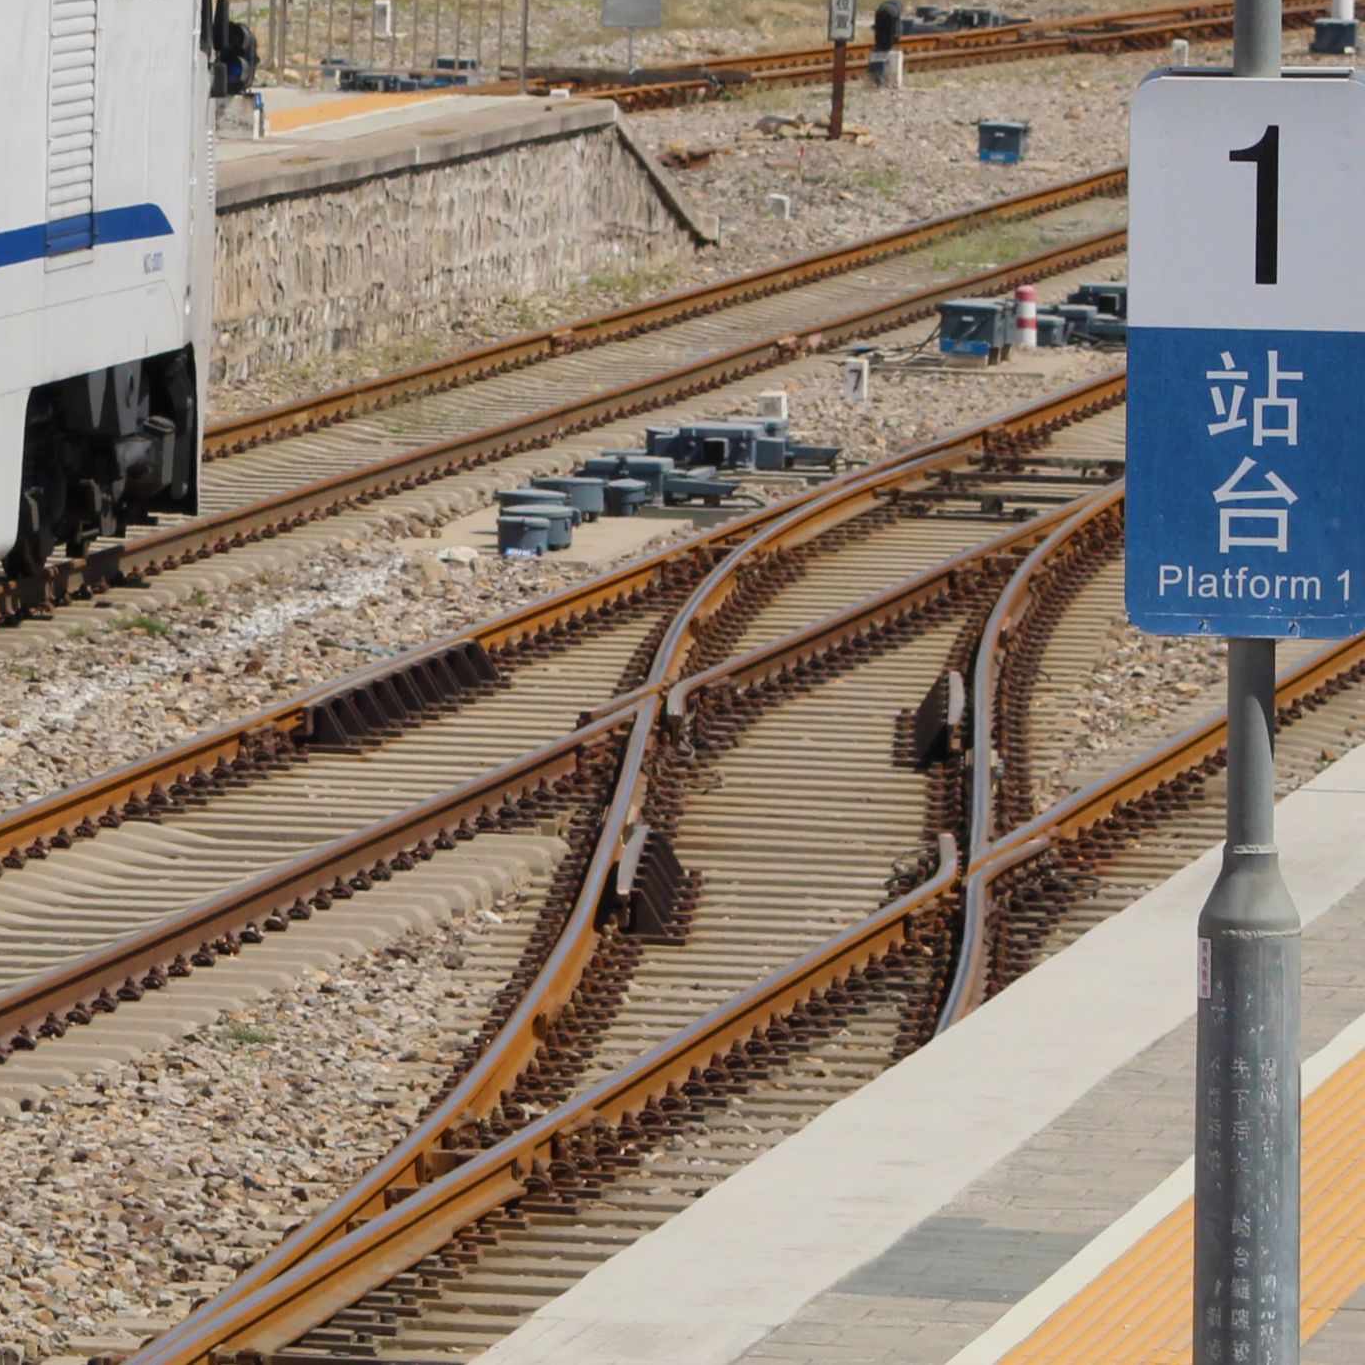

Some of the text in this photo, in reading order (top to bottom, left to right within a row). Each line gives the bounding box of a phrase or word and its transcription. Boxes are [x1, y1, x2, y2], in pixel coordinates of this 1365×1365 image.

[1228, 124, 1281, 286] 1
[1205, 349, 1305, 554] 站台
[1158, 565, 1353, 601] Platform 1
